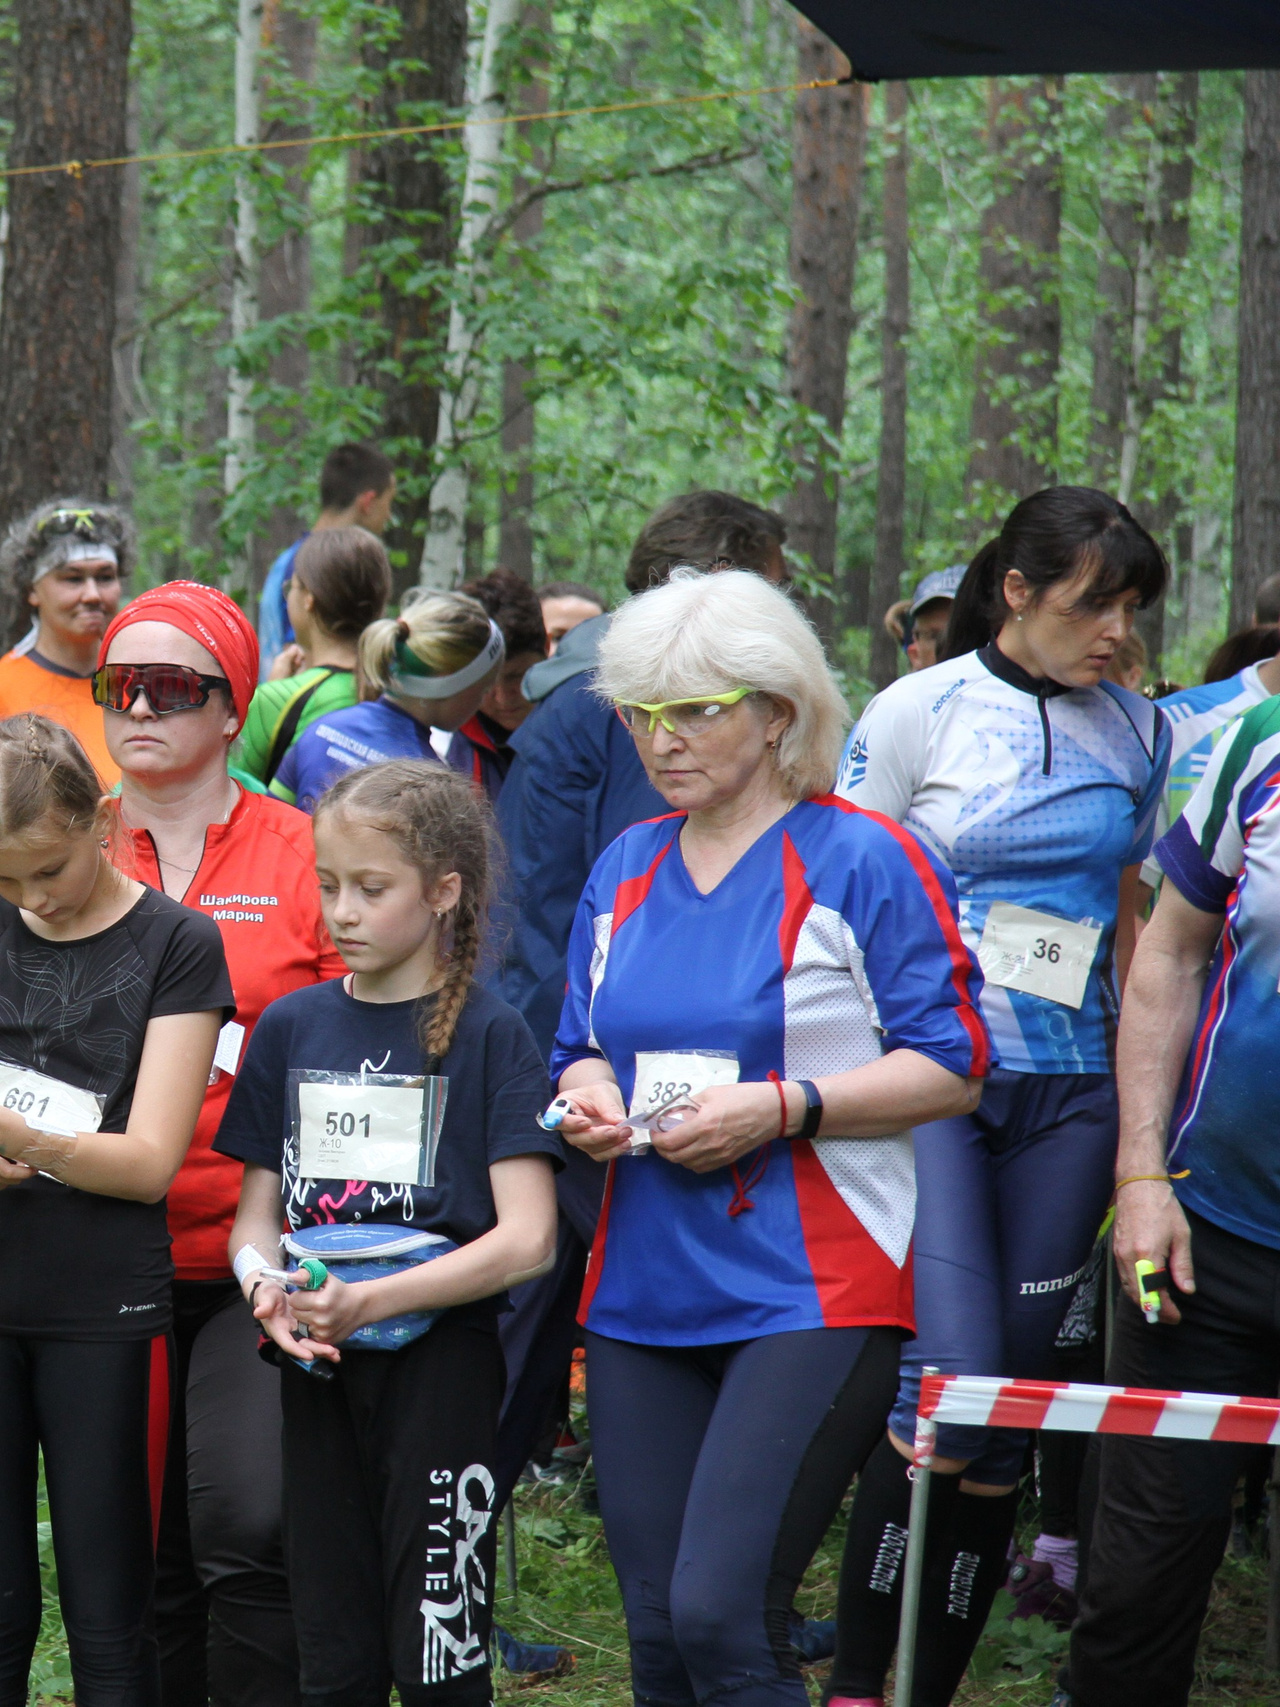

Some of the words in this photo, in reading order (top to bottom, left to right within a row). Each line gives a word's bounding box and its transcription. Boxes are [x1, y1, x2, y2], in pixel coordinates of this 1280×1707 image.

[200, 894, 278, 906] Шакирова
[213, 910, 263, 922] Мария
[1033, 938, 1062, 963] 36
[3, 1087, 50, 1118] 601
[325, 1111, 371, 1138] 501
[319, 1138, 342, 1149] Ж-10
[1019, 1266, 1086, 1294] nonam
[425, 1469, 453, 1591] STYLE
